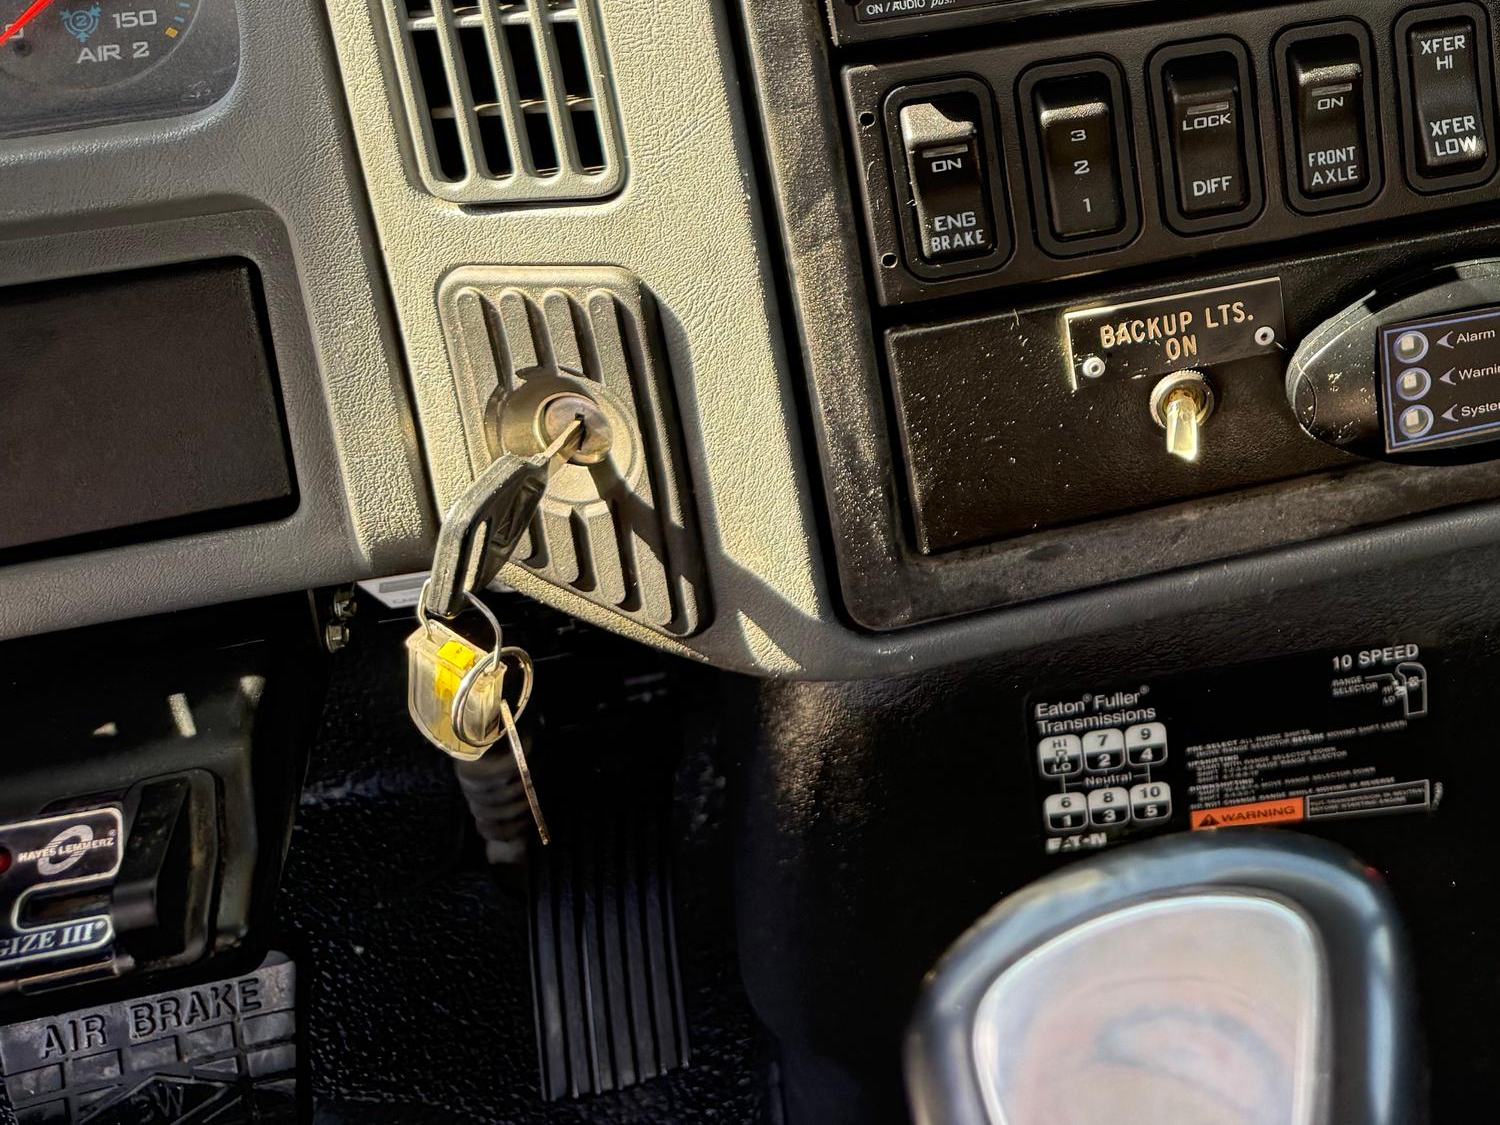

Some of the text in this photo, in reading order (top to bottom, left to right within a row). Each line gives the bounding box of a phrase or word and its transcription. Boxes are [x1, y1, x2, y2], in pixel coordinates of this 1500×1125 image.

[866, 2, 883, 15] ON
[112, 10, 157, 28] 150
[77, 41, 150, 64] AIR 2
[1421, 35, 1467, 55] XFER
[1436, 55, 1454, 71] HI
[1317, 96, 1344, 110] ON
[1182, 112, 1233, 131] LOCK
[1429, 115, 1476, 136] XFER
[1070, 129, 1087, 143] 3
[1434, 135, 1477, 157] LOW
[1307, 146, 1357, 168] FRONT
[931, 157, 963, 174] ON
[1073, 160, 1091, 175] 2
[1311, 166, 1358, 186] AXLE
[1192, 175, 1233, 197] DIFF
[1082, 198, 1092, 213] 1
[933, 211, 977, 232] ENG
[930, 228, 986, 253] BRAKE
[1100, 301, 1254, 349] BACKUP LTS.
[1456, 328, 1496, 345] Alarm
[1165, 335, 1198, 361] ON
[1333, 644, 1419, 670] 10 SPEED
[1332, 676, 1362, 687] RANGE
[1333, 682, 1378, 696] SELECTOR
[1037, 707, 1156, 734] Transmissions
[1097, 734, 1109, 747] 7
[1140, 728, 1152, 741] 9
[1053, 739, 1067, 749] HI
[1099, 754, 1111, 767] 2
[1141, 747, 1153, 761] 4
[1053, 762, 1072, 774] LO
[1085, 772, 1132, 787] Neutral
[1103, 791, 1114, 804] 8
[1140, 786, 1161, 799] 10
[1061, 796, 1072, 809] 6
[1103, 809, 1116, 823] 3
[1145, 804, 1157, 817] 5
[1221, 806, 1295, 822] WARNING
[1061, 814, 1072, 828] 1
[18, 848, 57, 863] HAYES
[0, 929, 56, 957] GIZE
[40, 977, 262, 1060] AIR BRAKE
